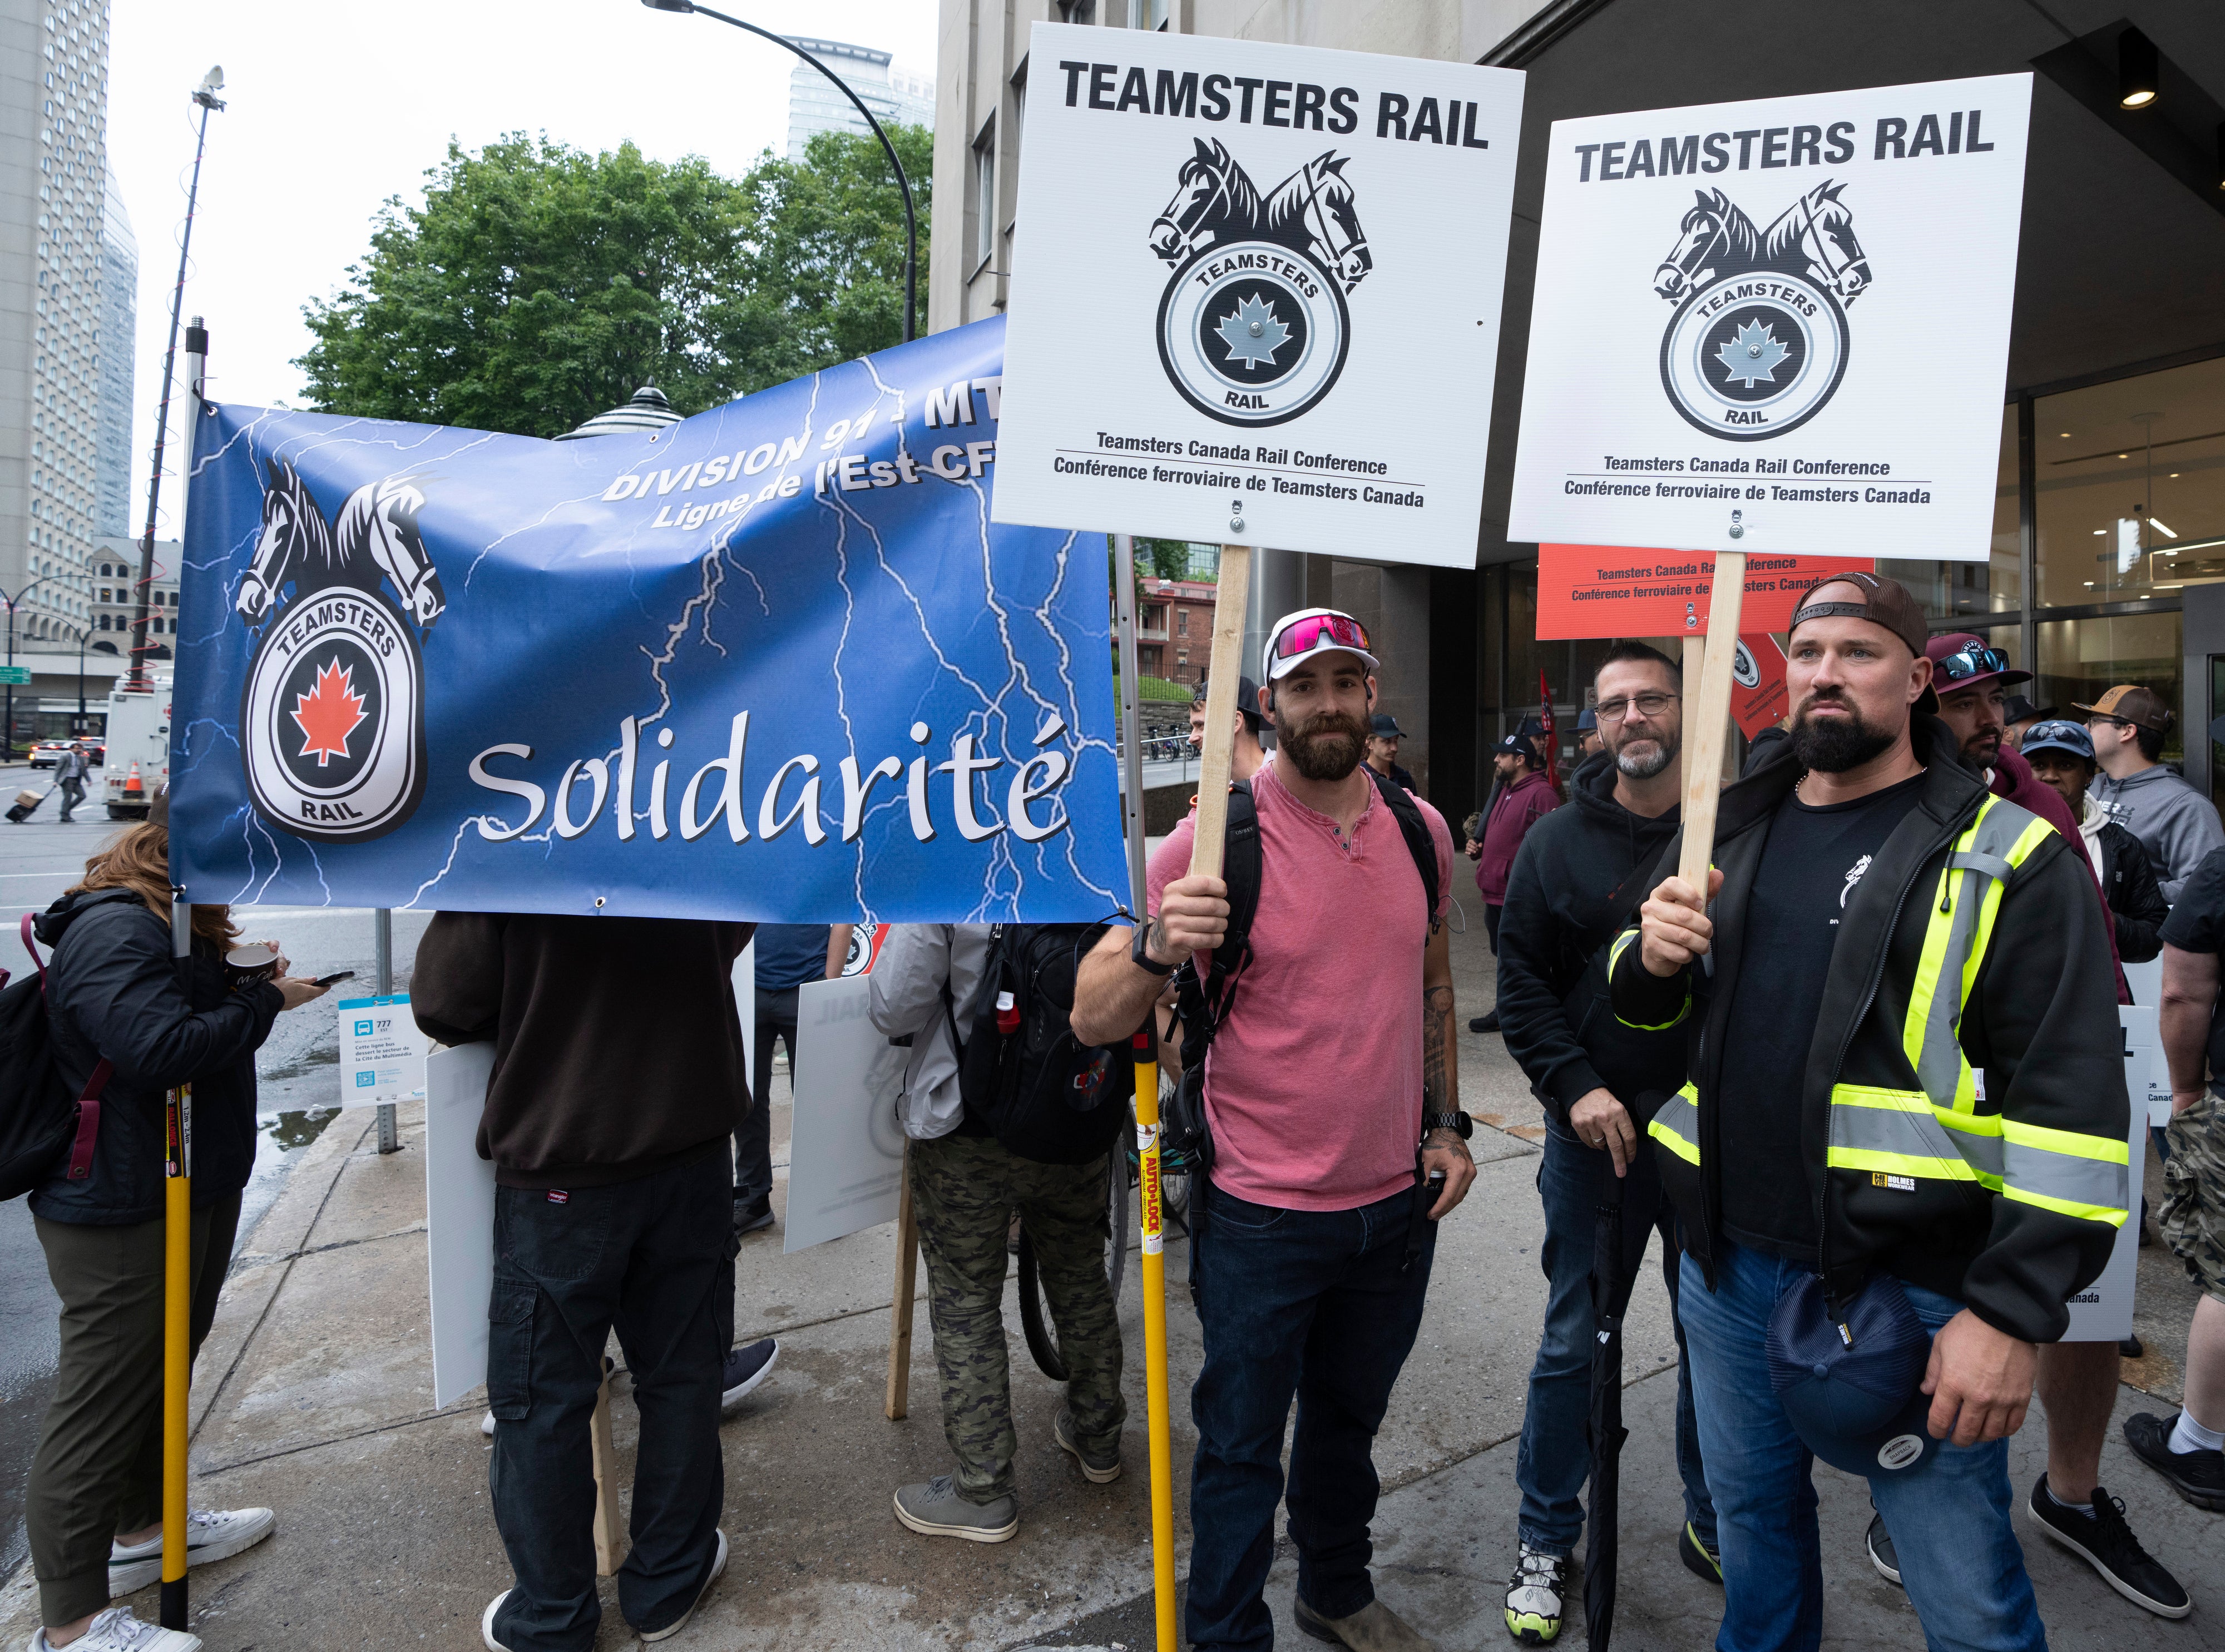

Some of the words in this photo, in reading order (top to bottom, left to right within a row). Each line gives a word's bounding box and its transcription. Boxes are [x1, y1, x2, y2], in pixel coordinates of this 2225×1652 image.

[1060, 60, 1359, 134] TEAMSTERS
[1376, 92, 1489, 149] RAIL
[1575, 121, 1855, 182] TEAMSTERS
[1874, 110, 1995, 161] RAIL
[1195, 254, 1319, 298] TEAMSTERS
[1697, 283, 1817, 317] TEAMSTERS
[1224, 390, 1269, 409] RAIL
[1724, 409, 1768, 424] RAIL
[601, 431, 813, 502] DIVISION
[820, 409, 877, 450] 91
[1097, 432, 1183, 454] Teamsters
[1188, 440, 1250, 461] Canada
[1256, 447, 1288, 464] Rail
[1293, 451, 1387, 475] Conference
[1604, 456, 1685, 472] Teamsters
[1690, 457, 1749, 472] Canada
[1756, 458, 1787, 473] Rail
[1793, 459, 1890, 475] Conference
[650, 493, 750, 531] Ligne
[756, 474, 803, 503] de
[932, 440, 997, 481] CF
[1054, 457, 1148, 480] Conférence
[1153, 466, 1240, 489] ferroviaire
[1246, 475, 1266, 491] de
[1272, 477, 1358, 501] Teamsters
[1363, 486, 1424, 507] Canada
[1565, 480, 1650, 497] Conférence
[1655, 482, 1741, 499] ferroviaire
[1746, 485, 1765, 499] de
[1771, 486, 1859, 502] Teamsters
[1865, 487, 1931, 504] Canada
[1597, 567, 1652, 580] Teamsters
[1655, 563, 1697, 576] Canada
[1701, 562, 1715, 573] Ra
[1746, 558, 1797, 571] ference
[1572, 588, 1630, 601] Conférence
[1633, 584, 1692, 598] ferroviaire
[1695, 583, 1709, 595] de
[1744, 580, 1776, 592] sters
[1779, 576, 1825, 590] Canad
[276, 602, 395, 657] TEAMSTERS
[468, 709, 1071, 846] Solidarité
[301, 799, 364, 821] RAIL
[376, 1020, 391, 1028] 777
[1976, 1090, 1980, 1099] 3M
[168, 1106, 177, 1147] RALLONGE
[1887, 1175, 1915, 1186] HOLMES
[1887, 1183, 1915, 1191] WORKWEAR
[2065, 1292, 2099, 1303] anada
[1889, 1444, 1912, 1460] SNAPBACK
